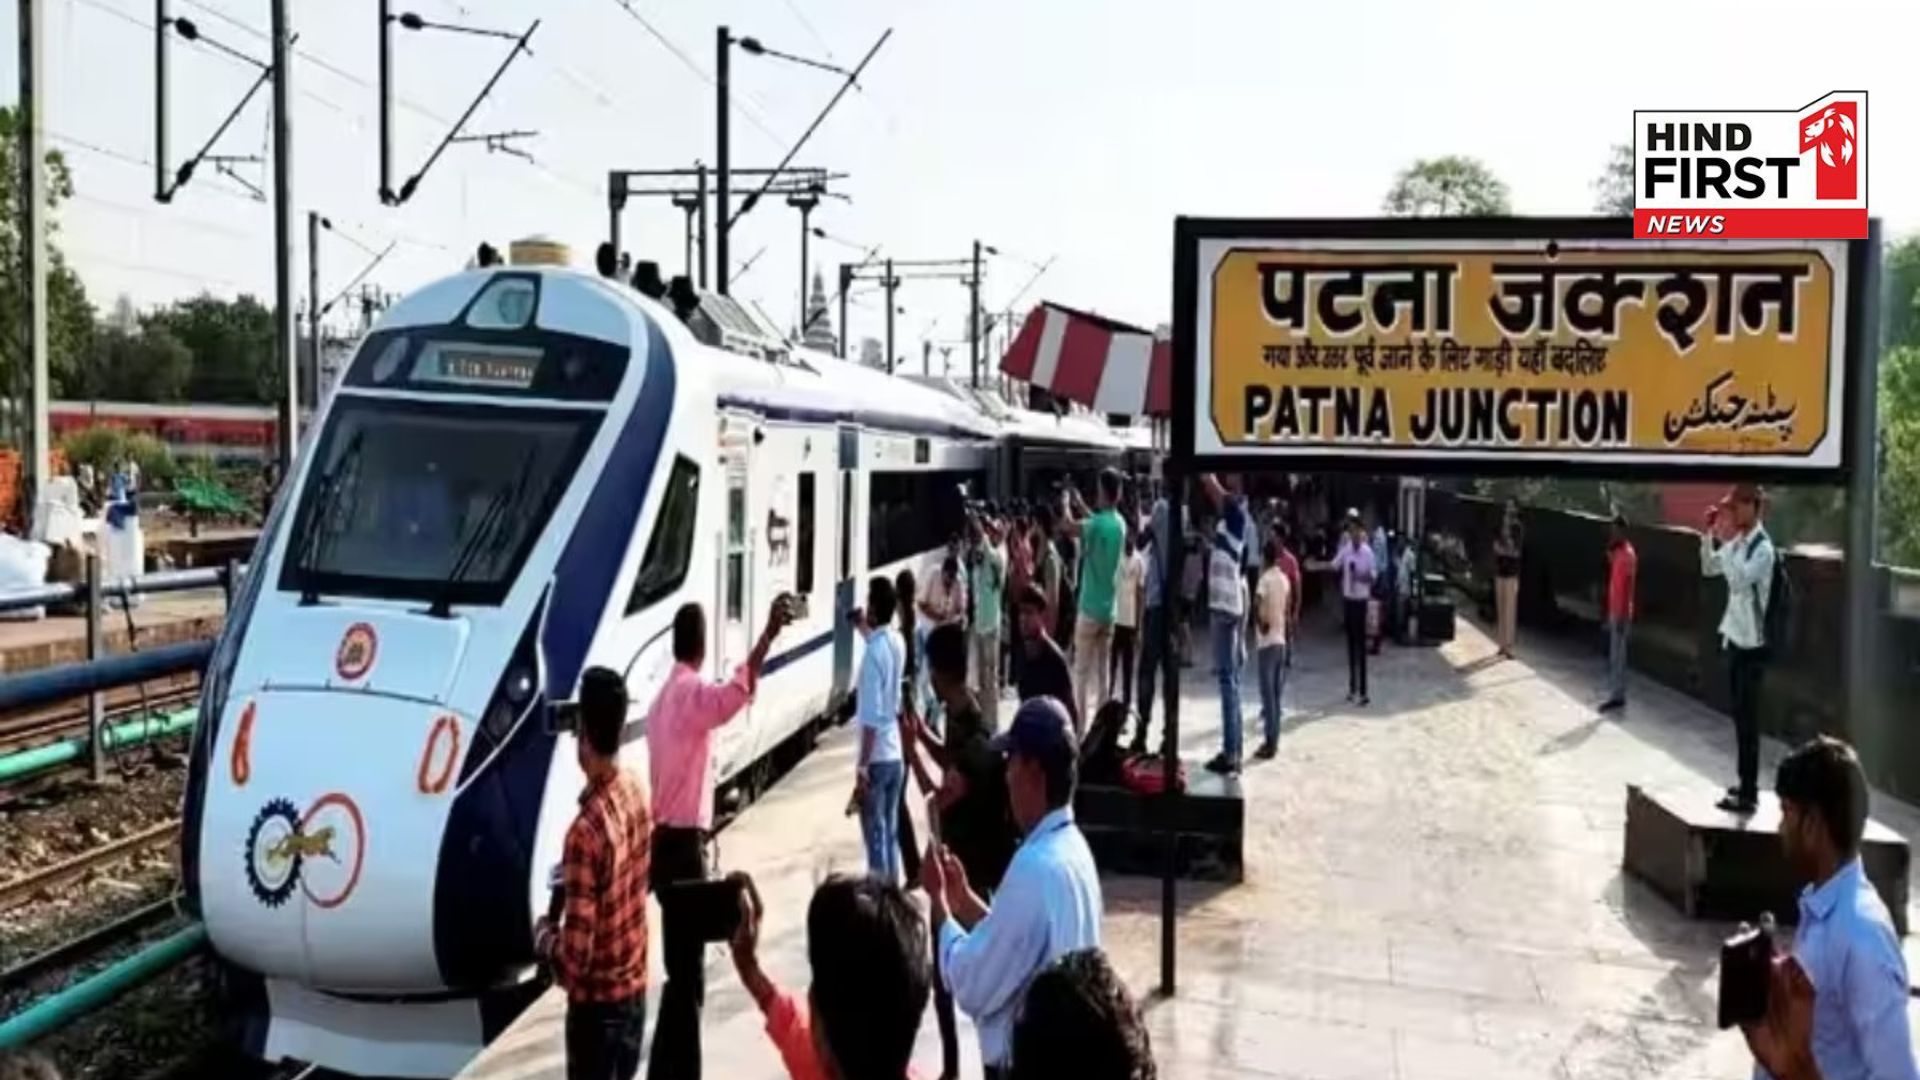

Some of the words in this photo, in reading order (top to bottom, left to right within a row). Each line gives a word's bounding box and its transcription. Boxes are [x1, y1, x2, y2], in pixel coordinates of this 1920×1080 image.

[1257, 262, 1461, 335] पटना
[1417, 338, 1436, 371] के
[1244, 385, 1392, 440] PATNA
[1409, 387, 1631, 446] JUNCTION
